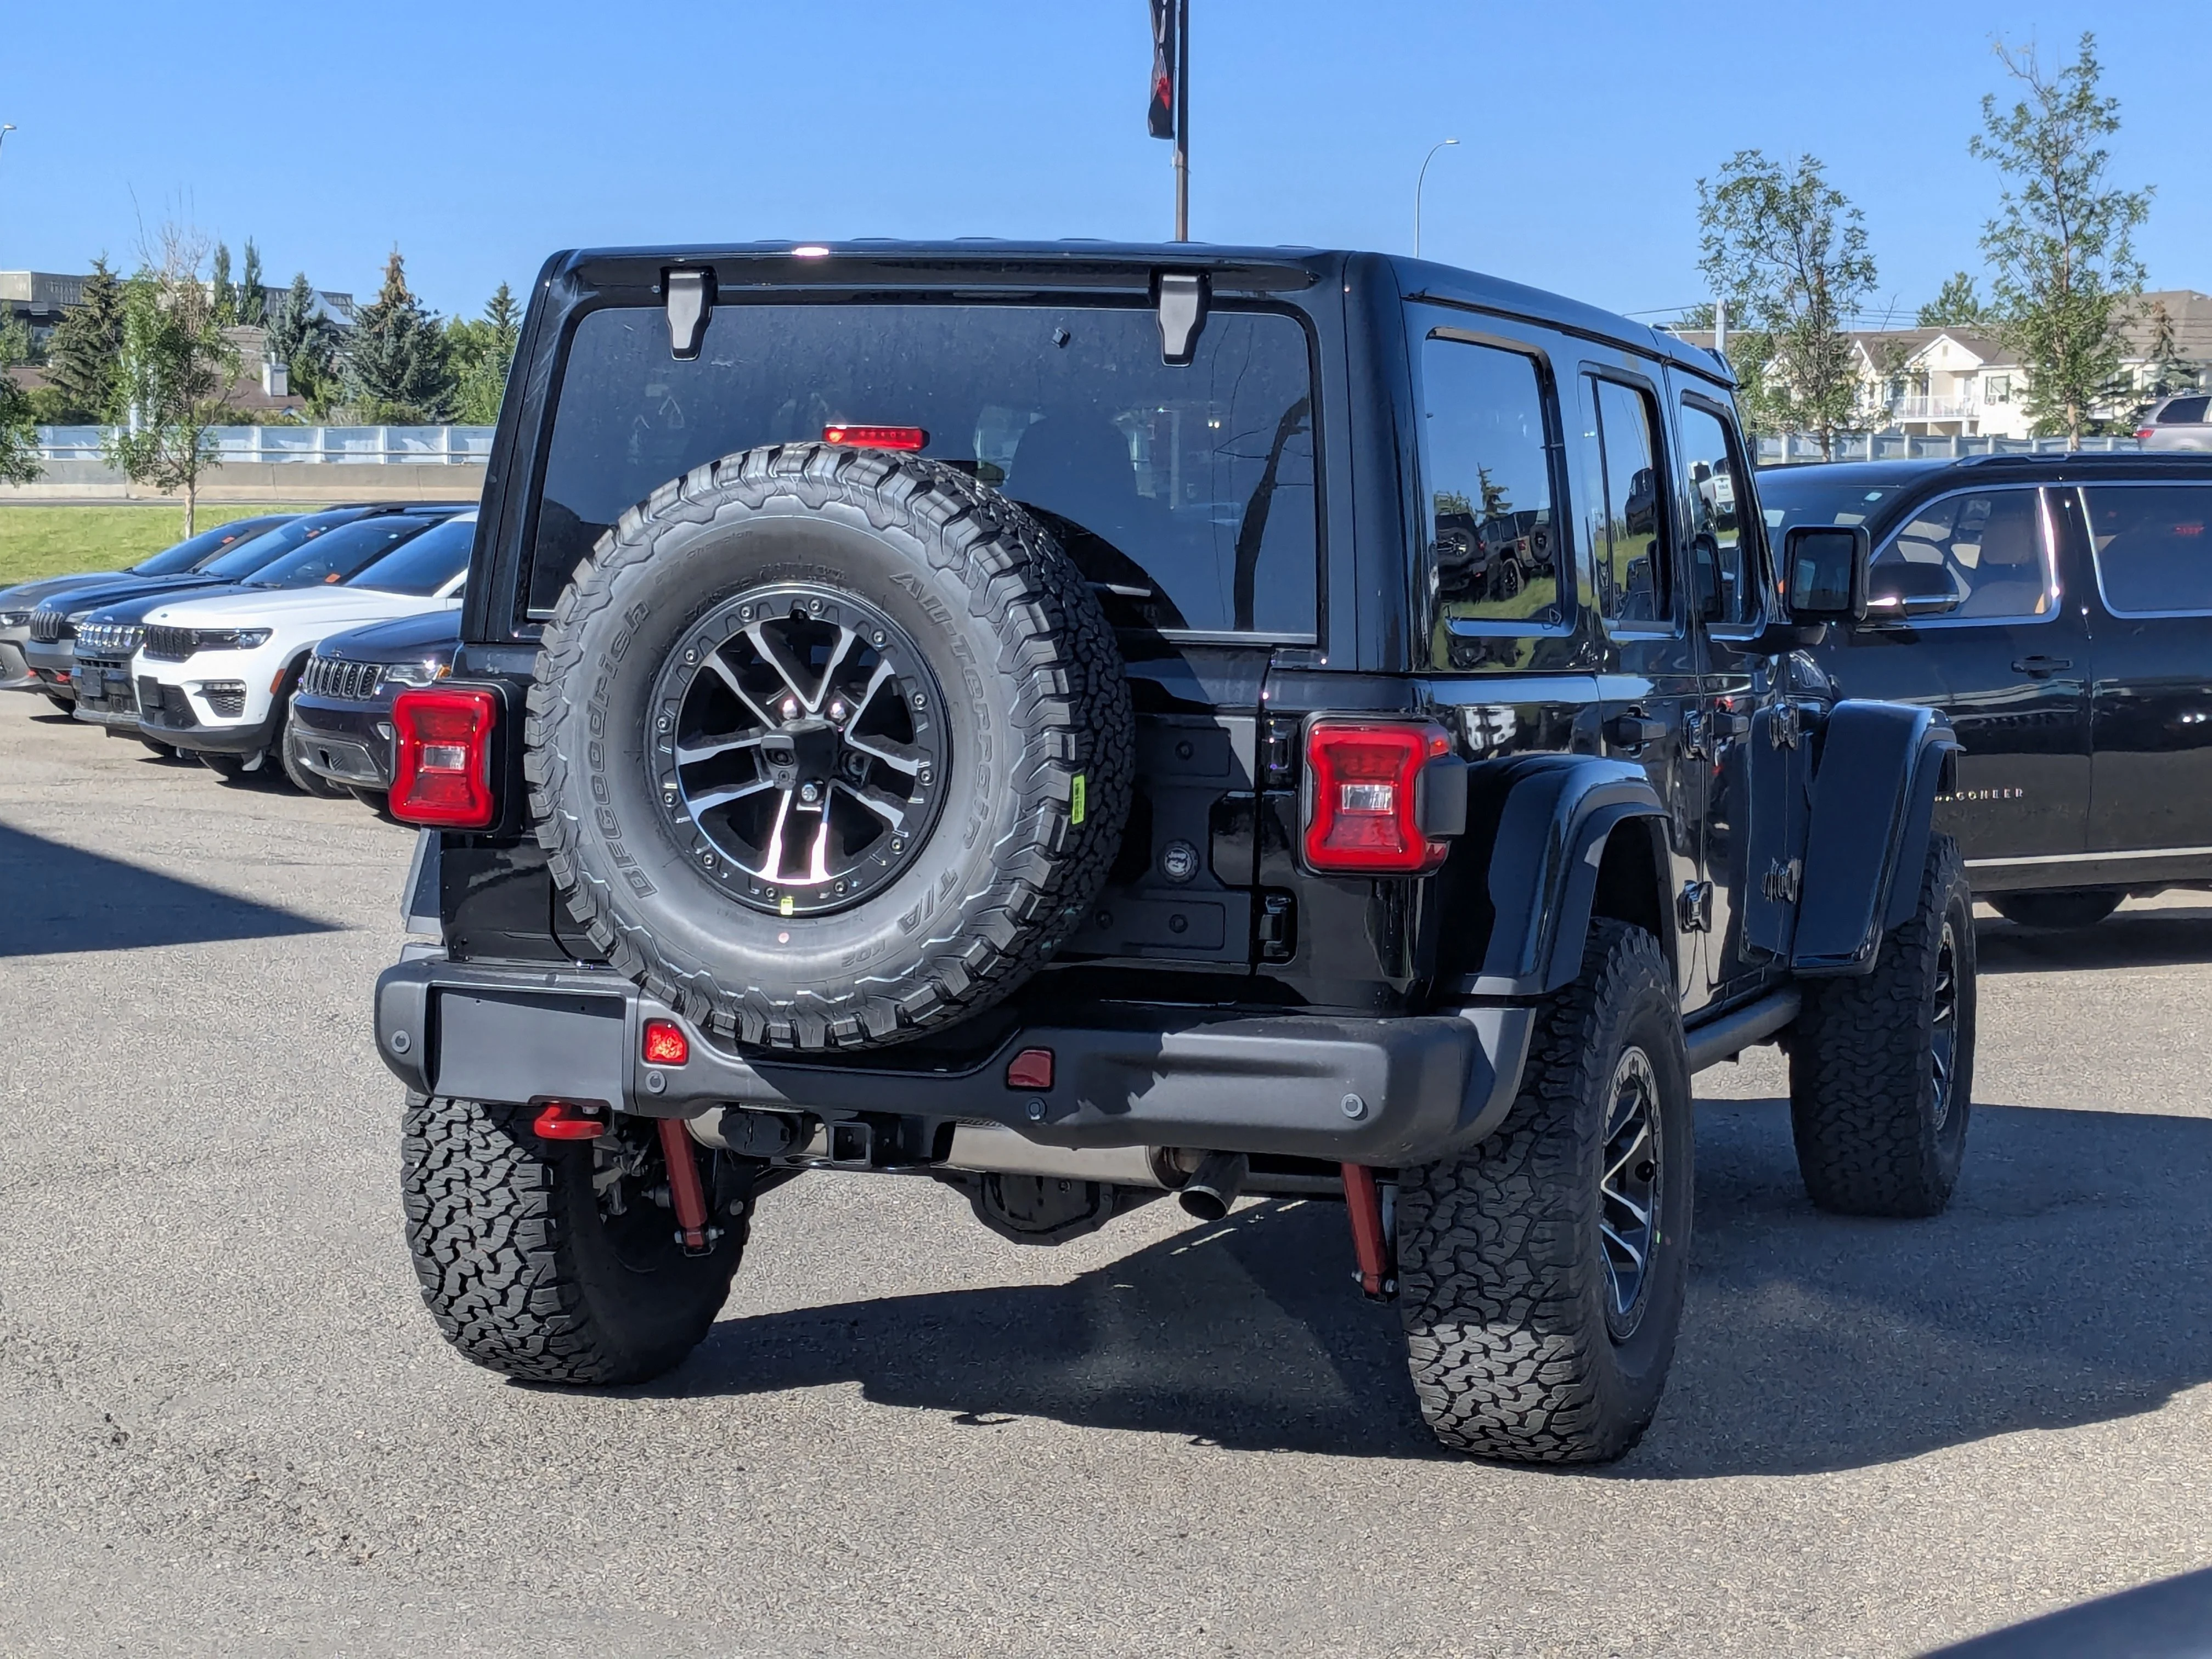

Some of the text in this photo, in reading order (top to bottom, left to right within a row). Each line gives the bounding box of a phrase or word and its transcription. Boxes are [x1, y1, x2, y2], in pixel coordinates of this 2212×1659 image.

[586, 600, 658, 899] BFGoodrich
[889, 572, 992, 849] All-Terrain
[896, 867, 958, 936] T/A
